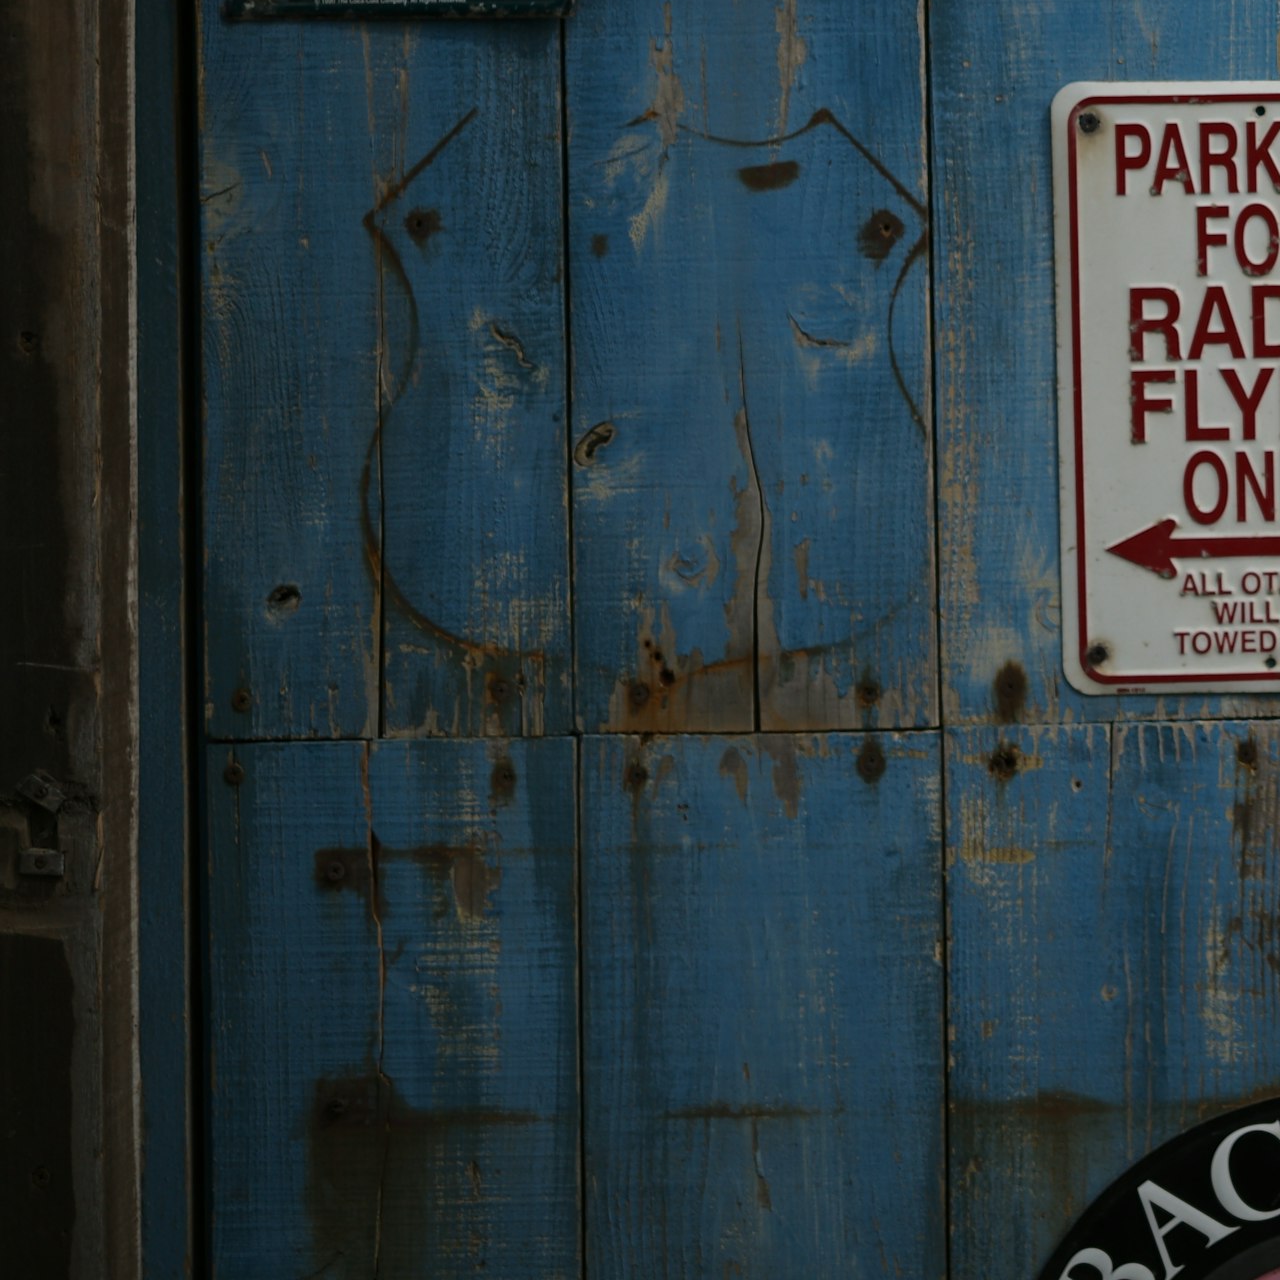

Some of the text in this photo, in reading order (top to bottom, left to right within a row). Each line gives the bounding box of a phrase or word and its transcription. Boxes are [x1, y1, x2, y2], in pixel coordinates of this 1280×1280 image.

[1180, 572, 1234, 597] ALL
[1213, 601, 1280, 625] WILL
[1173, 629, 1280, 655] TOWED
